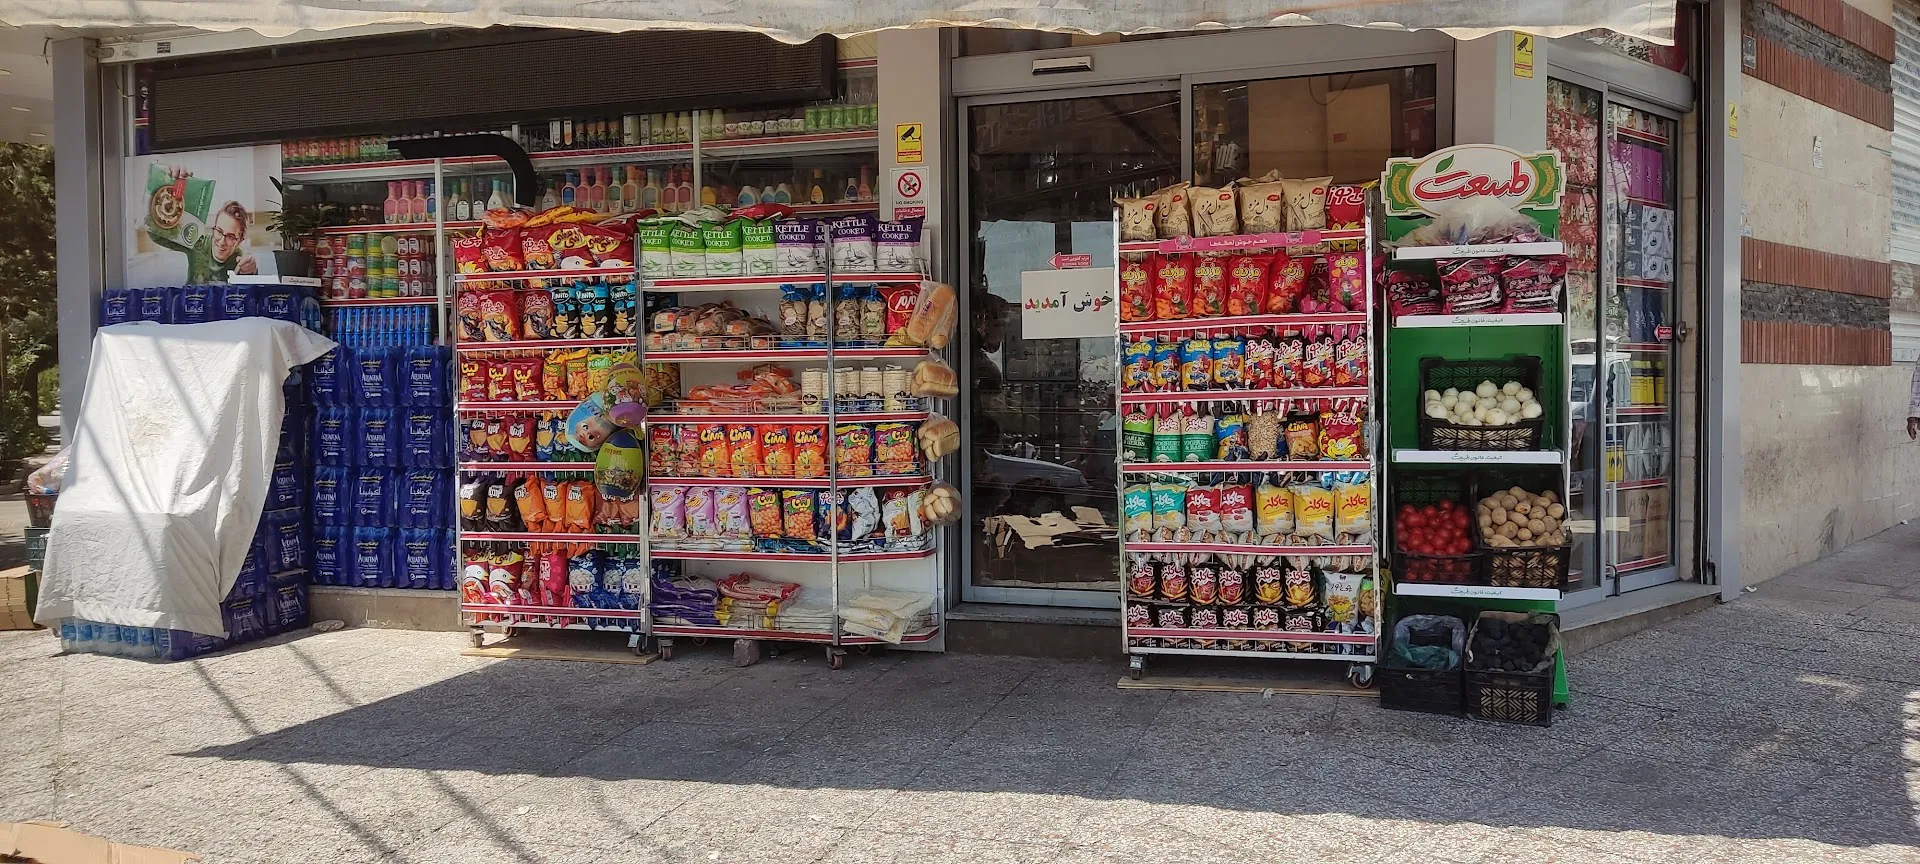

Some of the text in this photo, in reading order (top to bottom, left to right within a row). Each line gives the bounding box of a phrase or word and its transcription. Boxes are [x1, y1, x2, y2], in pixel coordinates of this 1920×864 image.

[1414, 158, 1531, 201] طبیعت
[1208, 199, 1222, 215] دل
[1255, 199, 1269, 215] دل
[1300, 192, 1314, 209] دل
[832, 218, 868, 229] KETTLE
[1133, 207, 1147, 224] دل
[742, 225, 775, 235] KETTLE
[775, 224, 810, 233] KETTLE
[838, 227, 866, 236] COOKED
[878, 223, 914, 233] KETTLE
[778, 233, 806, 241] COOKED
[881, 232, 910, 241] COOKED
[1236, 239, 1256, 247] خوش
[1025, 290, 1113, 313] خوش آمدید
[1125, 495, 1147, 511] چاکلز
[1153, 492, 1175, 508] چاکلز
[1187, 492, 1211, 508] چاکلز
[1221, 491, 1246, 506] چاکلز
[1263, 494, 1289, 510] چاکلز
[1304, 497, 1331, 511] چاکلز
[1342, 493, 1368, 509] چاکلز
